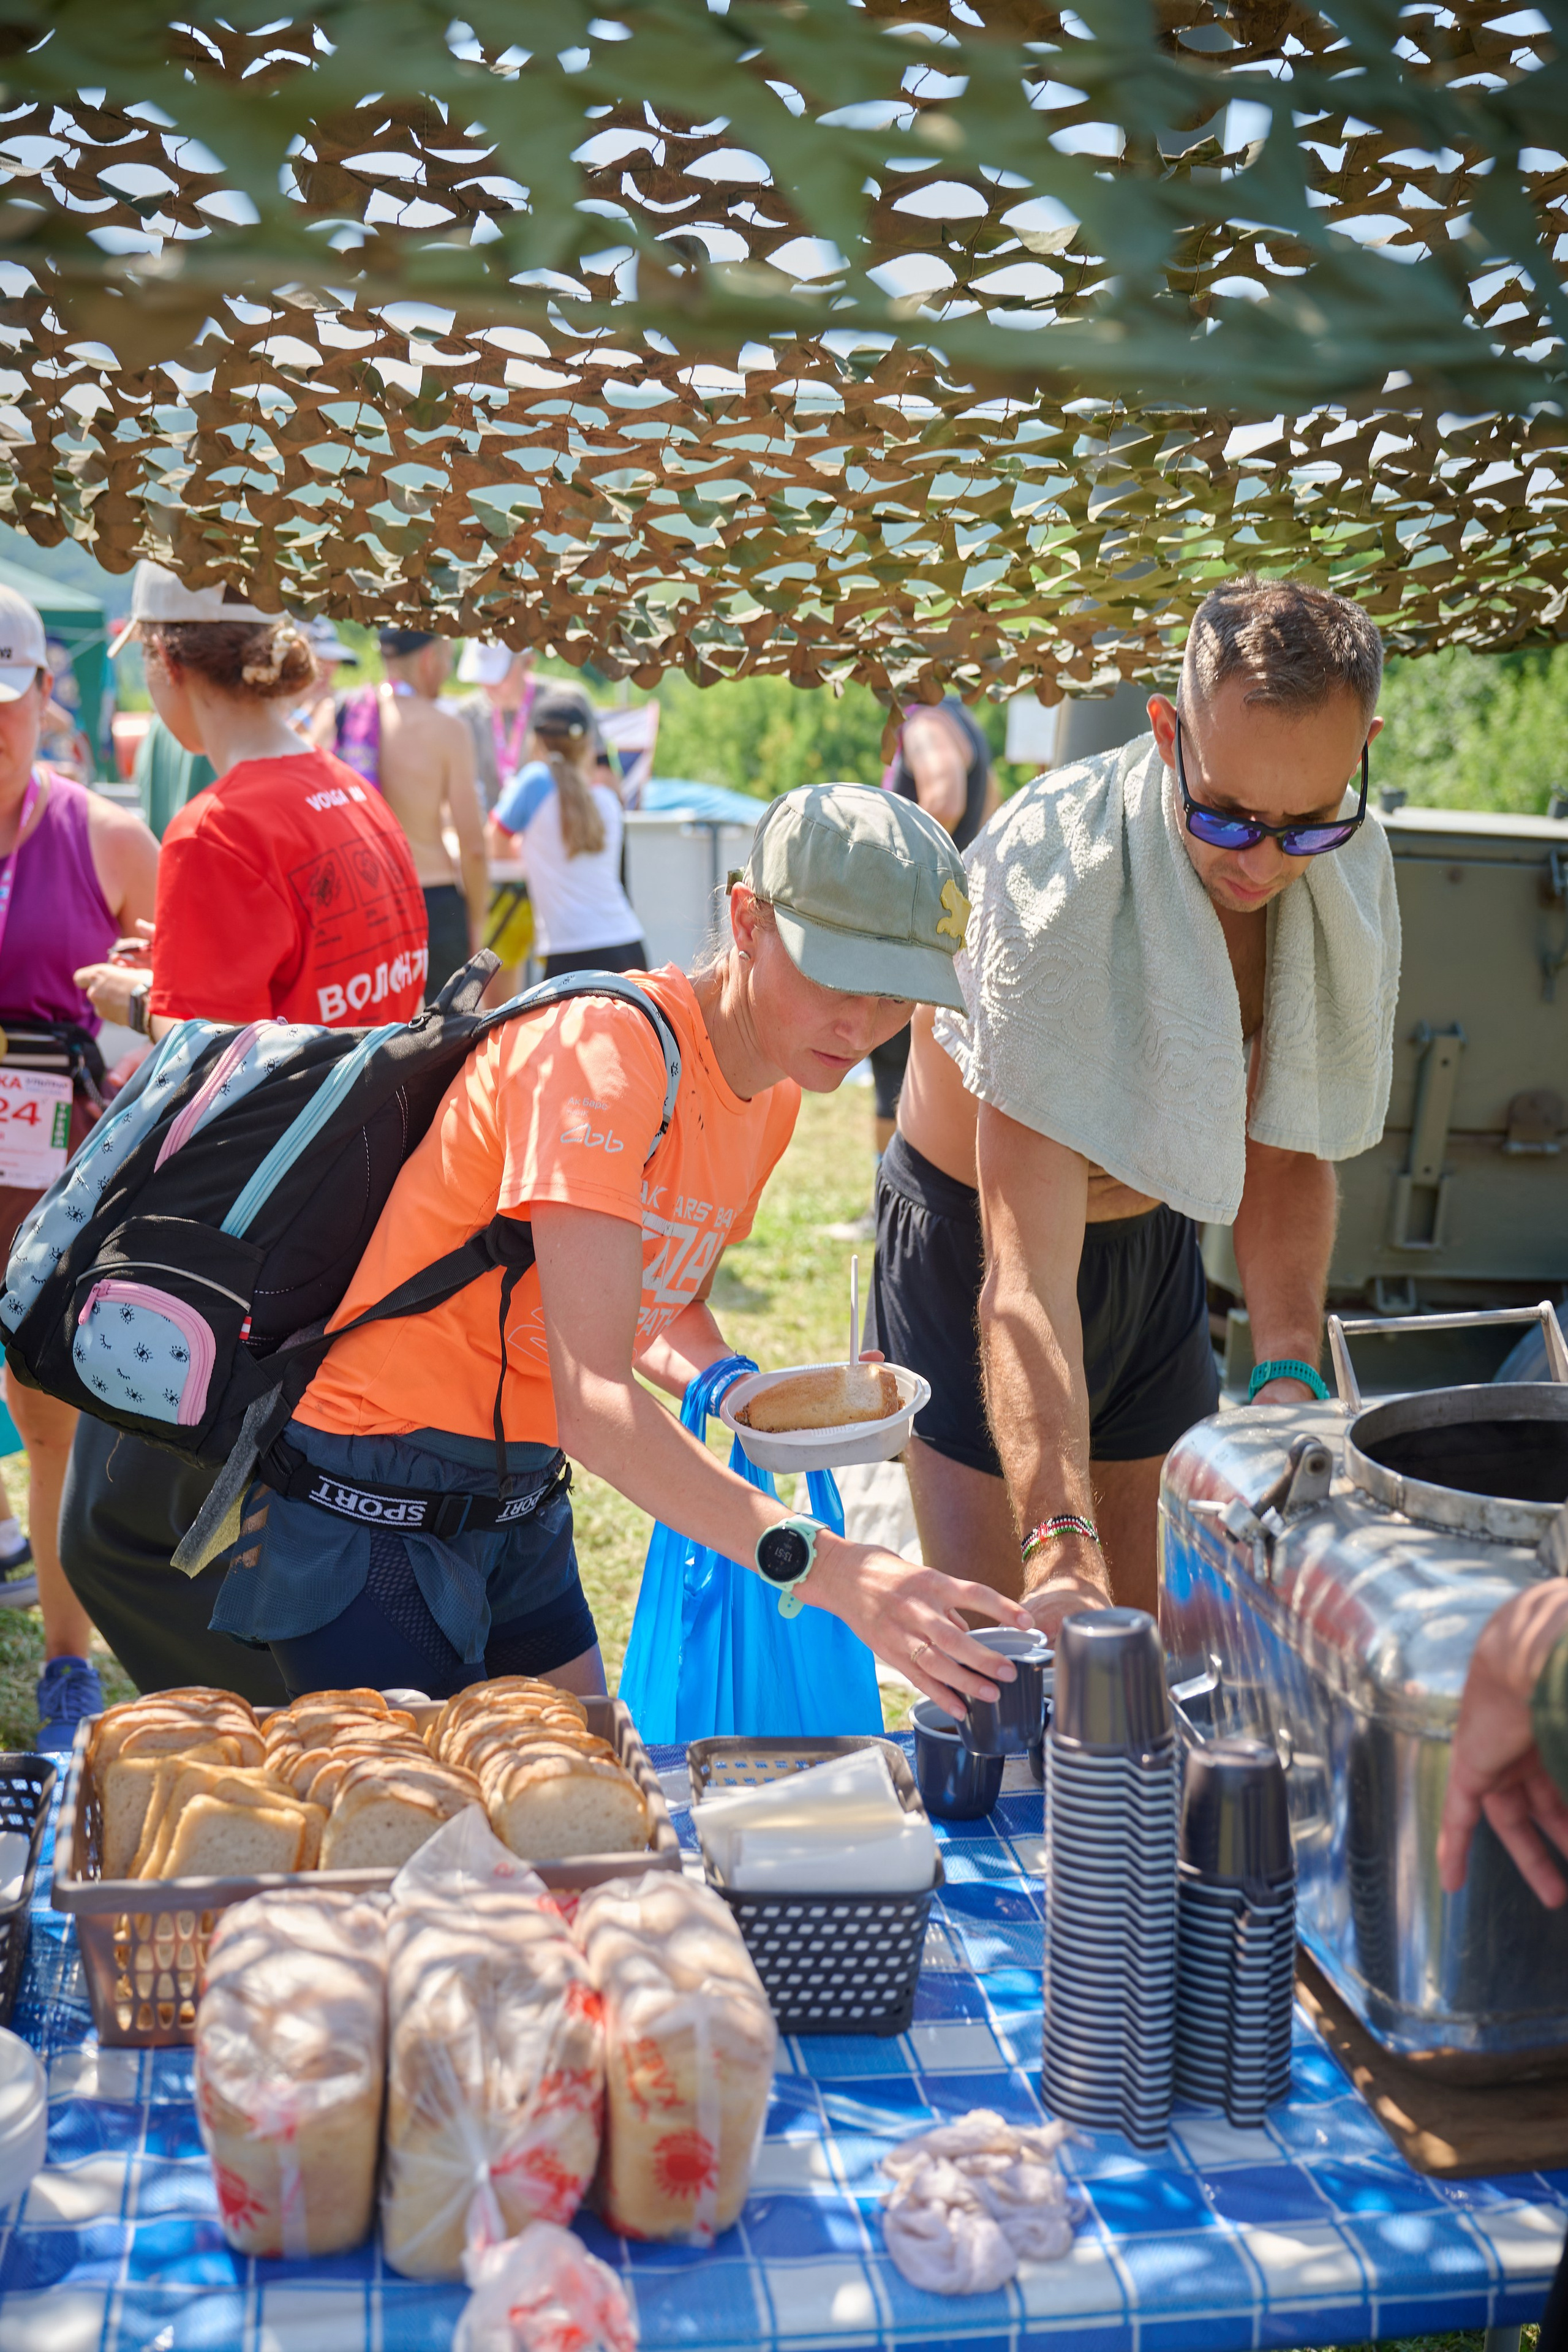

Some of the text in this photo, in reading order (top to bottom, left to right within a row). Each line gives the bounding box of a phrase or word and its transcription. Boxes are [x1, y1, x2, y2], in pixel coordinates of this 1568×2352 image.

[674, 1195, 713, 1223] ARS
[714, 1207, 735, 1228] BA
[311, 1482, 426, 1521] SPORT
